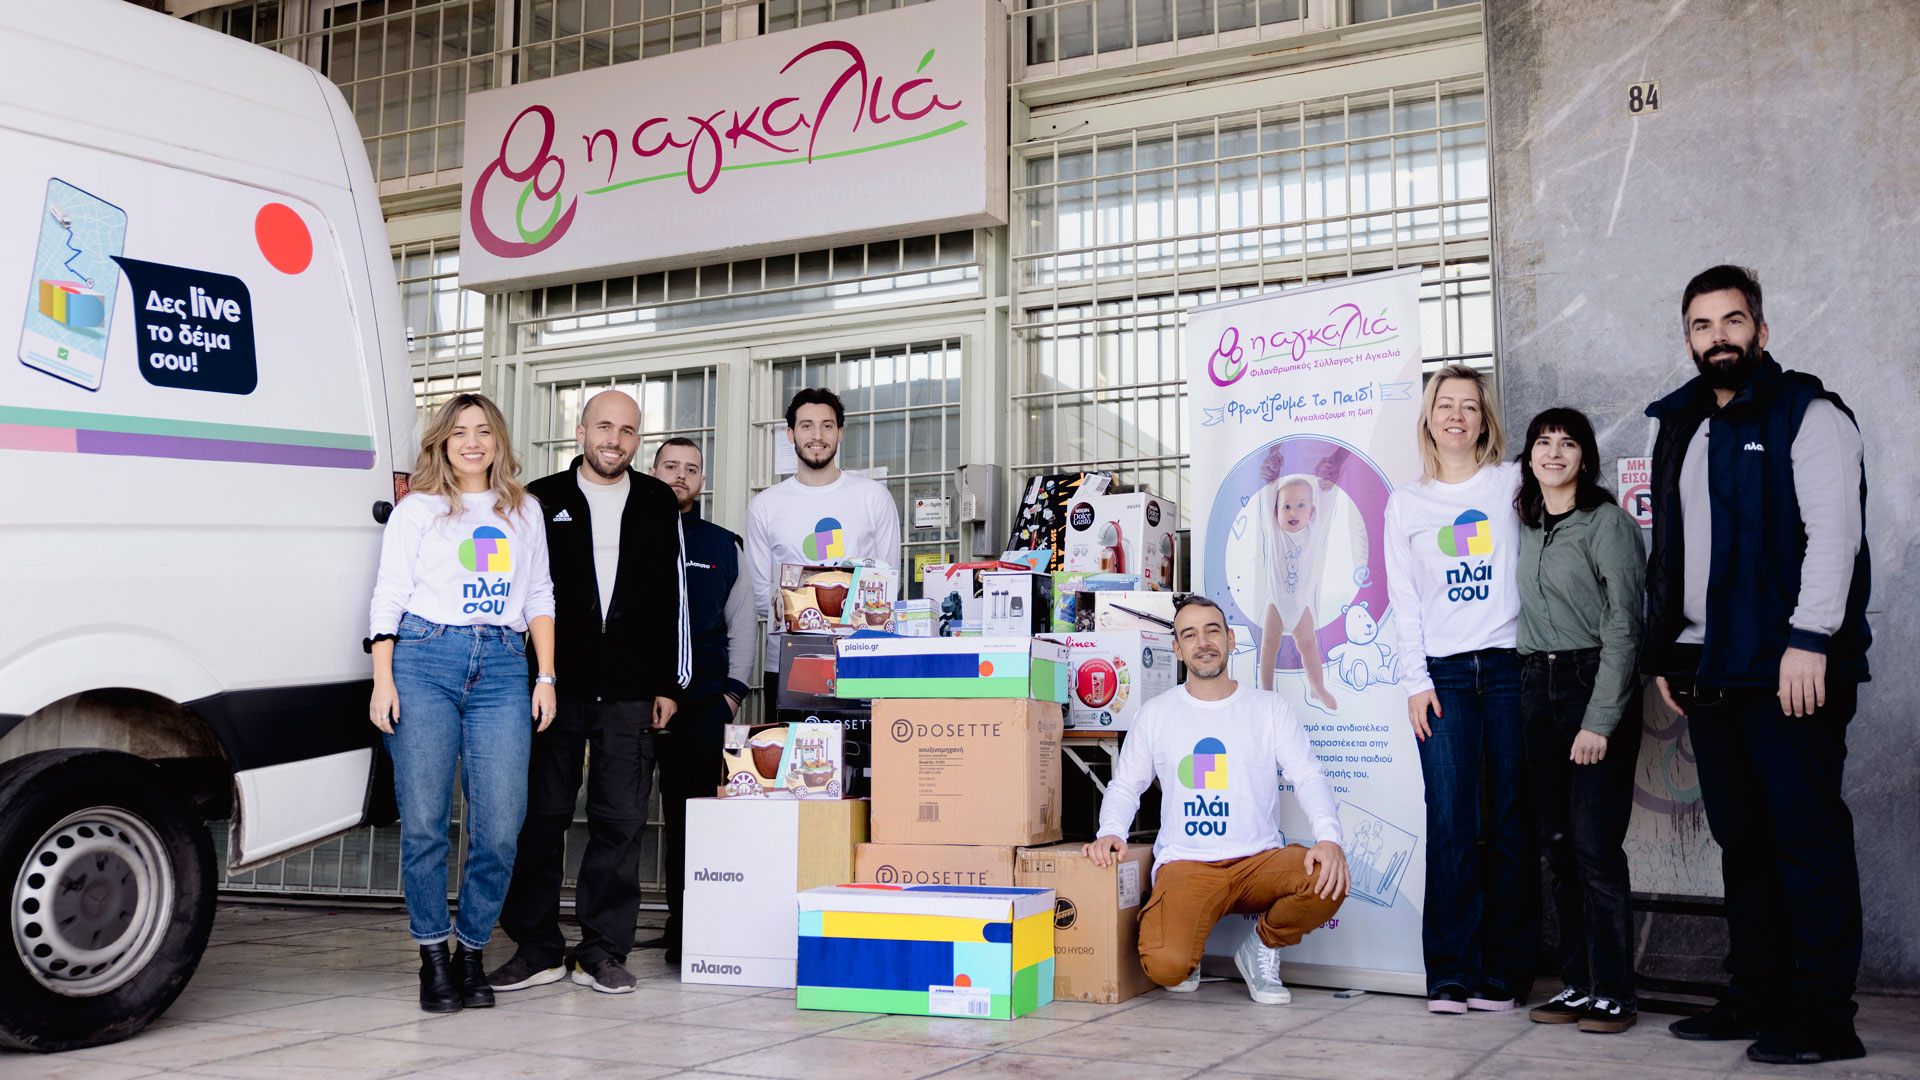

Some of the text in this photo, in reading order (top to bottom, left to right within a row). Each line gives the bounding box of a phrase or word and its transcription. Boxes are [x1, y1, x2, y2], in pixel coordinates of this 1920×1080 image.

[1629, 84, 1658, 112] 84
[583, 40, 962, 194] η αγκαλιά
[145, 286, 241, 322] Δες live
[147, 323, 230, 352] το δέμα
[1250, 303, 1398, 361] η αγκαλιά
[150, 352, 198, 373] σου!
[1250, 362, 1312, 377] Φιλανθρωπικός
[1313, 356, 1354, 369] Σύλλογος
[1364, 349, 1401, 362] Αγκαλιά
[1227, 381, 1374, 424] Φροντίζουμε το Παιδί
[1294, 408, 1374, 423] Αγκαλιάζουμε τη ζωή
[1627, 460, 1646, 471] ΜΗ
[1073, 512, 1091, 520] Dolce
[1073, 518, 1091, 526] Gusto
[1446, 560, 1493, 585] πλάι
[463, 577, 511, 598] πλάι
[1447, 585, 1490, 602] σου
[463, 599, 505, 616] σου
[845, 642, 880, 652] plaisio.gr
[1065, 636, 1097, 648] linex
[917, 723, 1001, 738] DOSETTE
[1303, 723, 1320, 733] σμό
[1336, 723, 1389, 732] ανιδιοτέλεια
[1369, 741, 1389, 749] στην
[1316, 755, 1343, 763] τασία
[1361, 754, 1393, 763] παιδιού
[1324, 769, 1352, 779] ύησής
[1184, 794, 1229, 817] πλάι
[1185, 820, 1226, 836] σου
[694, 868, 744, 882] πλαισιο
[901, 871, 987, 886] DOSETTE
[1067, 946, 1095, 955] HYDRO
[691, 960, 742, 975] πλαισιο
